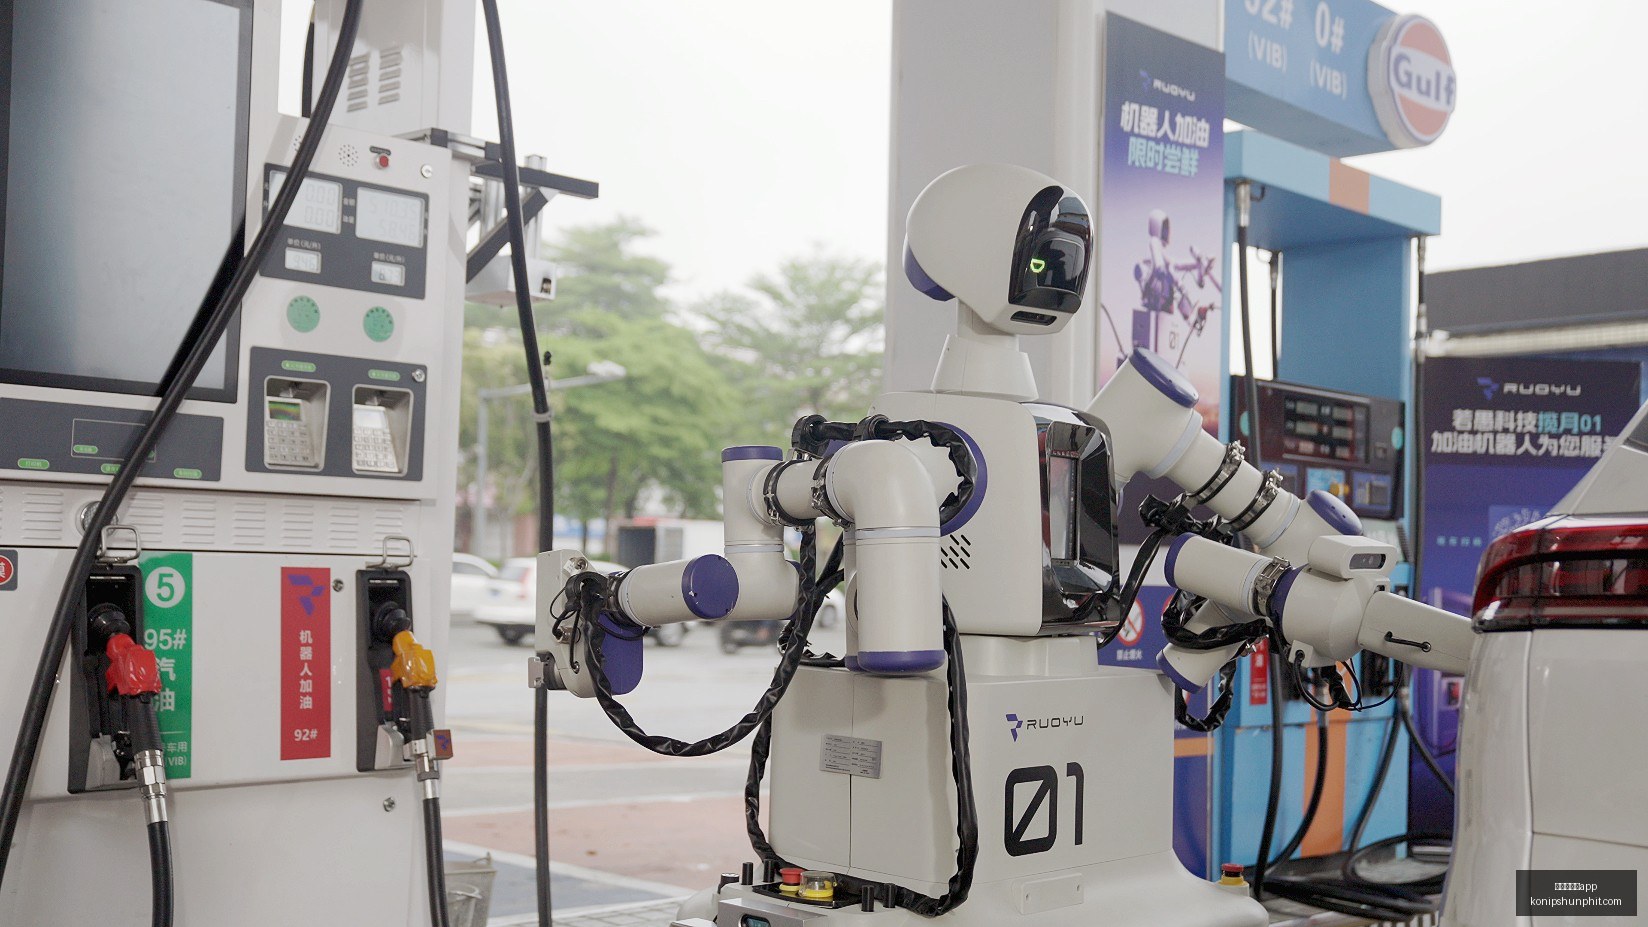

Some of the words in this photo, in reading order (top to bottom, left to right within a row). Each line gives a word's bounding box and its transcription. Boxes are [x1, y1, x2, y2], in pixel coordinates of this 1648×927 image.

[1315, 1, 1345, 54] 0#
[1248, 30, 1288, 73] (VIB)
[1153, 79, 1196, 101] RUOYU
[1310, 59, 1347, 100] (VIB)
[1393, 53, 1454, 106] Gulf
[1121, 100, 1210, 149] 机器人加油
[1127, 136, 1200, 178] 限时尝鲜
[1503, 382, 1582, 397] RUOYU
[156, 573, 175, 602] 5
[144, 628, 187, 650] 95#
[299, 630, 313, 710] 机器人加油
[294, 729, 318, 741] 92#
[1027, 715, 1084, 730] RUOYU
[162, 741, 188, 753] 车用
[1004, 761, 1085, 857] 01
